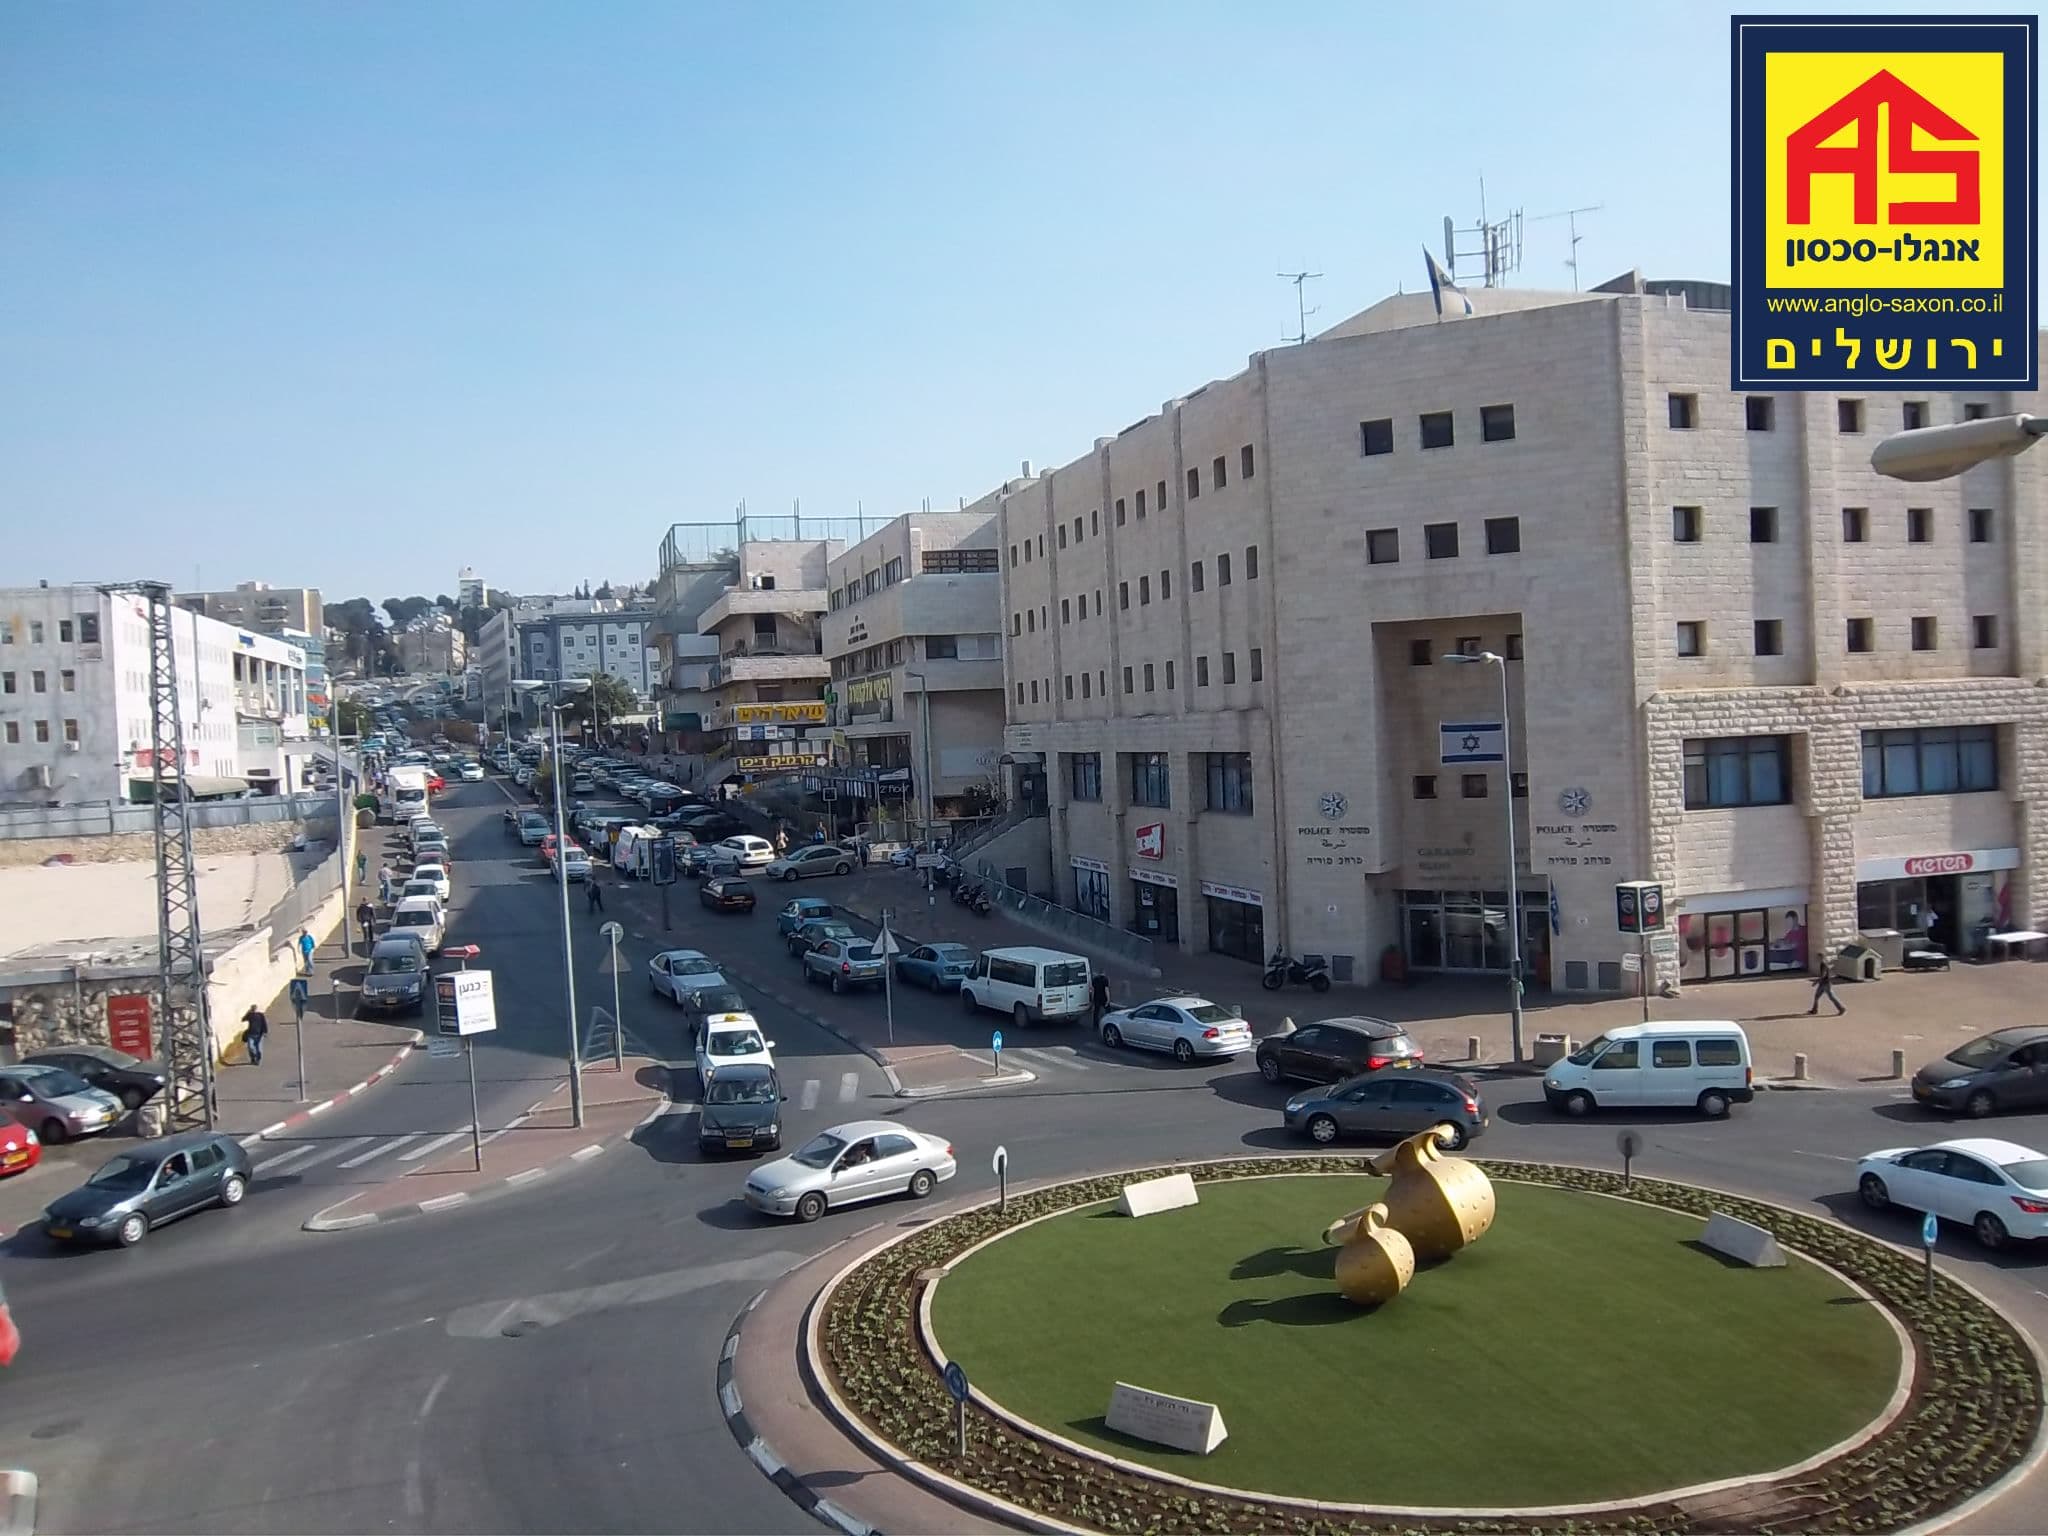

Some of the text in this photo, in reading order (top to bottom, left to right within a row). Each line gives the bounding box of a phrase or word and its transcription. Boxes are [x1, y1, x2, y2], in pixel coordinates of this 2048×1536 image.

[1298, 827, 1332, 836] POLICE
[1536, 825, 1574, 835] POLICE
[459, 981, 482, 997] כנען
